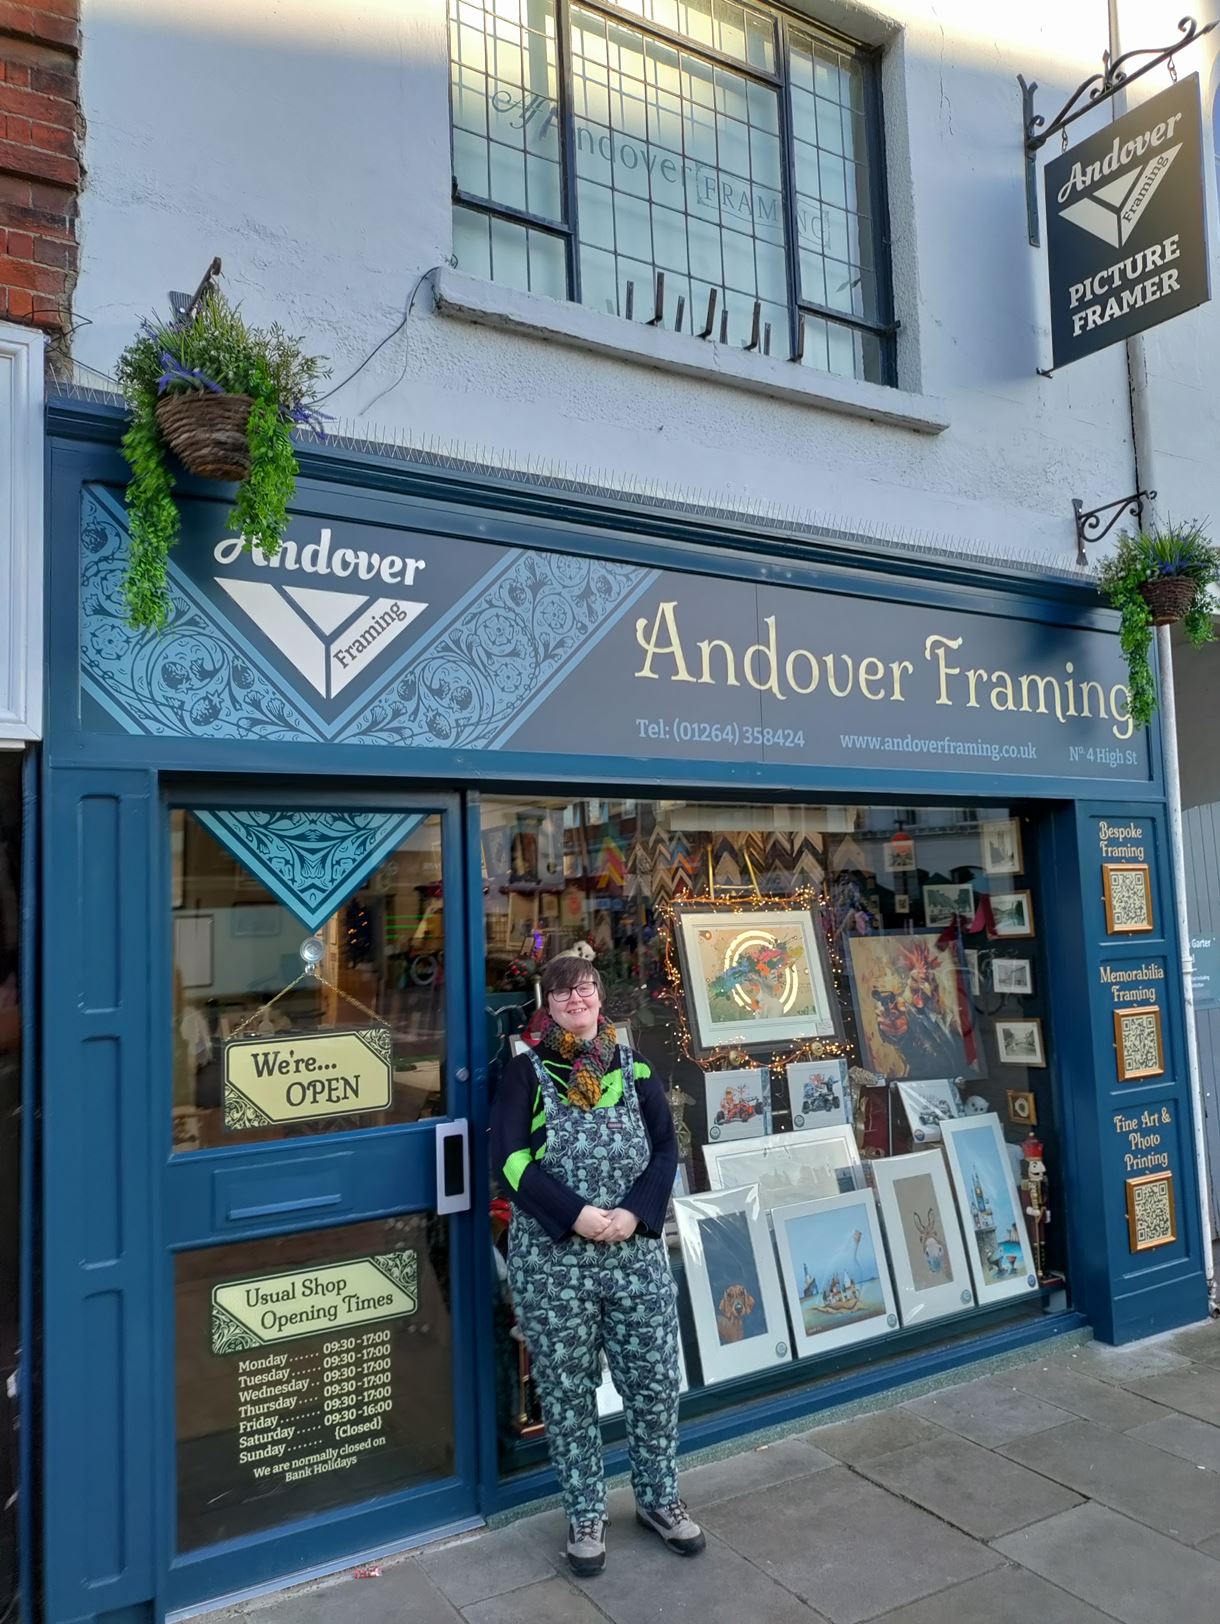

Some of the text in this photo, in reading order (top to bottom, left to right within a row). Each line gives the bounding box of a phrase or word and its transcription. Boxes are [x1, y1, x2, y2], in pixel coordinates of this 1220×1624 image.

[1057, 112, 1182, 203] Andover
[1122, 155, 1169, 223] Framing
[1069, 234, 1180, 309] PICTURE
[1072, 269, 1180, 337] FRAMER
[333, 602, 407, 669] Framing
[634, 601, 1133, 740] Andover Framing
[636, 718, 805, 748] Tel: (01264) 358424
[840, 733, 1037, 762] www.andoverframing.co.uk
[1086, 748, 1095, 761] 4
[1096, 748, 1124, 768] High
[1125, 750, 1138, 765] St
[1099, 821, 1142, 842] Bespoke
[1100, 841, 1144, 861] Framing
[1100, 963, 1164, 984] Memorabilia
[1112, 986, 1155, 1003] Framing
[286, 1075, 360, 1107] OPEN
[1113, 1107, 1171, 1133] Fine Art &
[1129, 1132, 1160, 1150] Photo
[1124, 1152, 1168, 1172] Printing
[245, 1277, 347, 1307] Usual Shop
[260, 1293, 393, 1332] Opening Times
[253, 1436, 386, 1478] We are normally closed on
[285, 1456, 357, 1482] Bank Holidays
